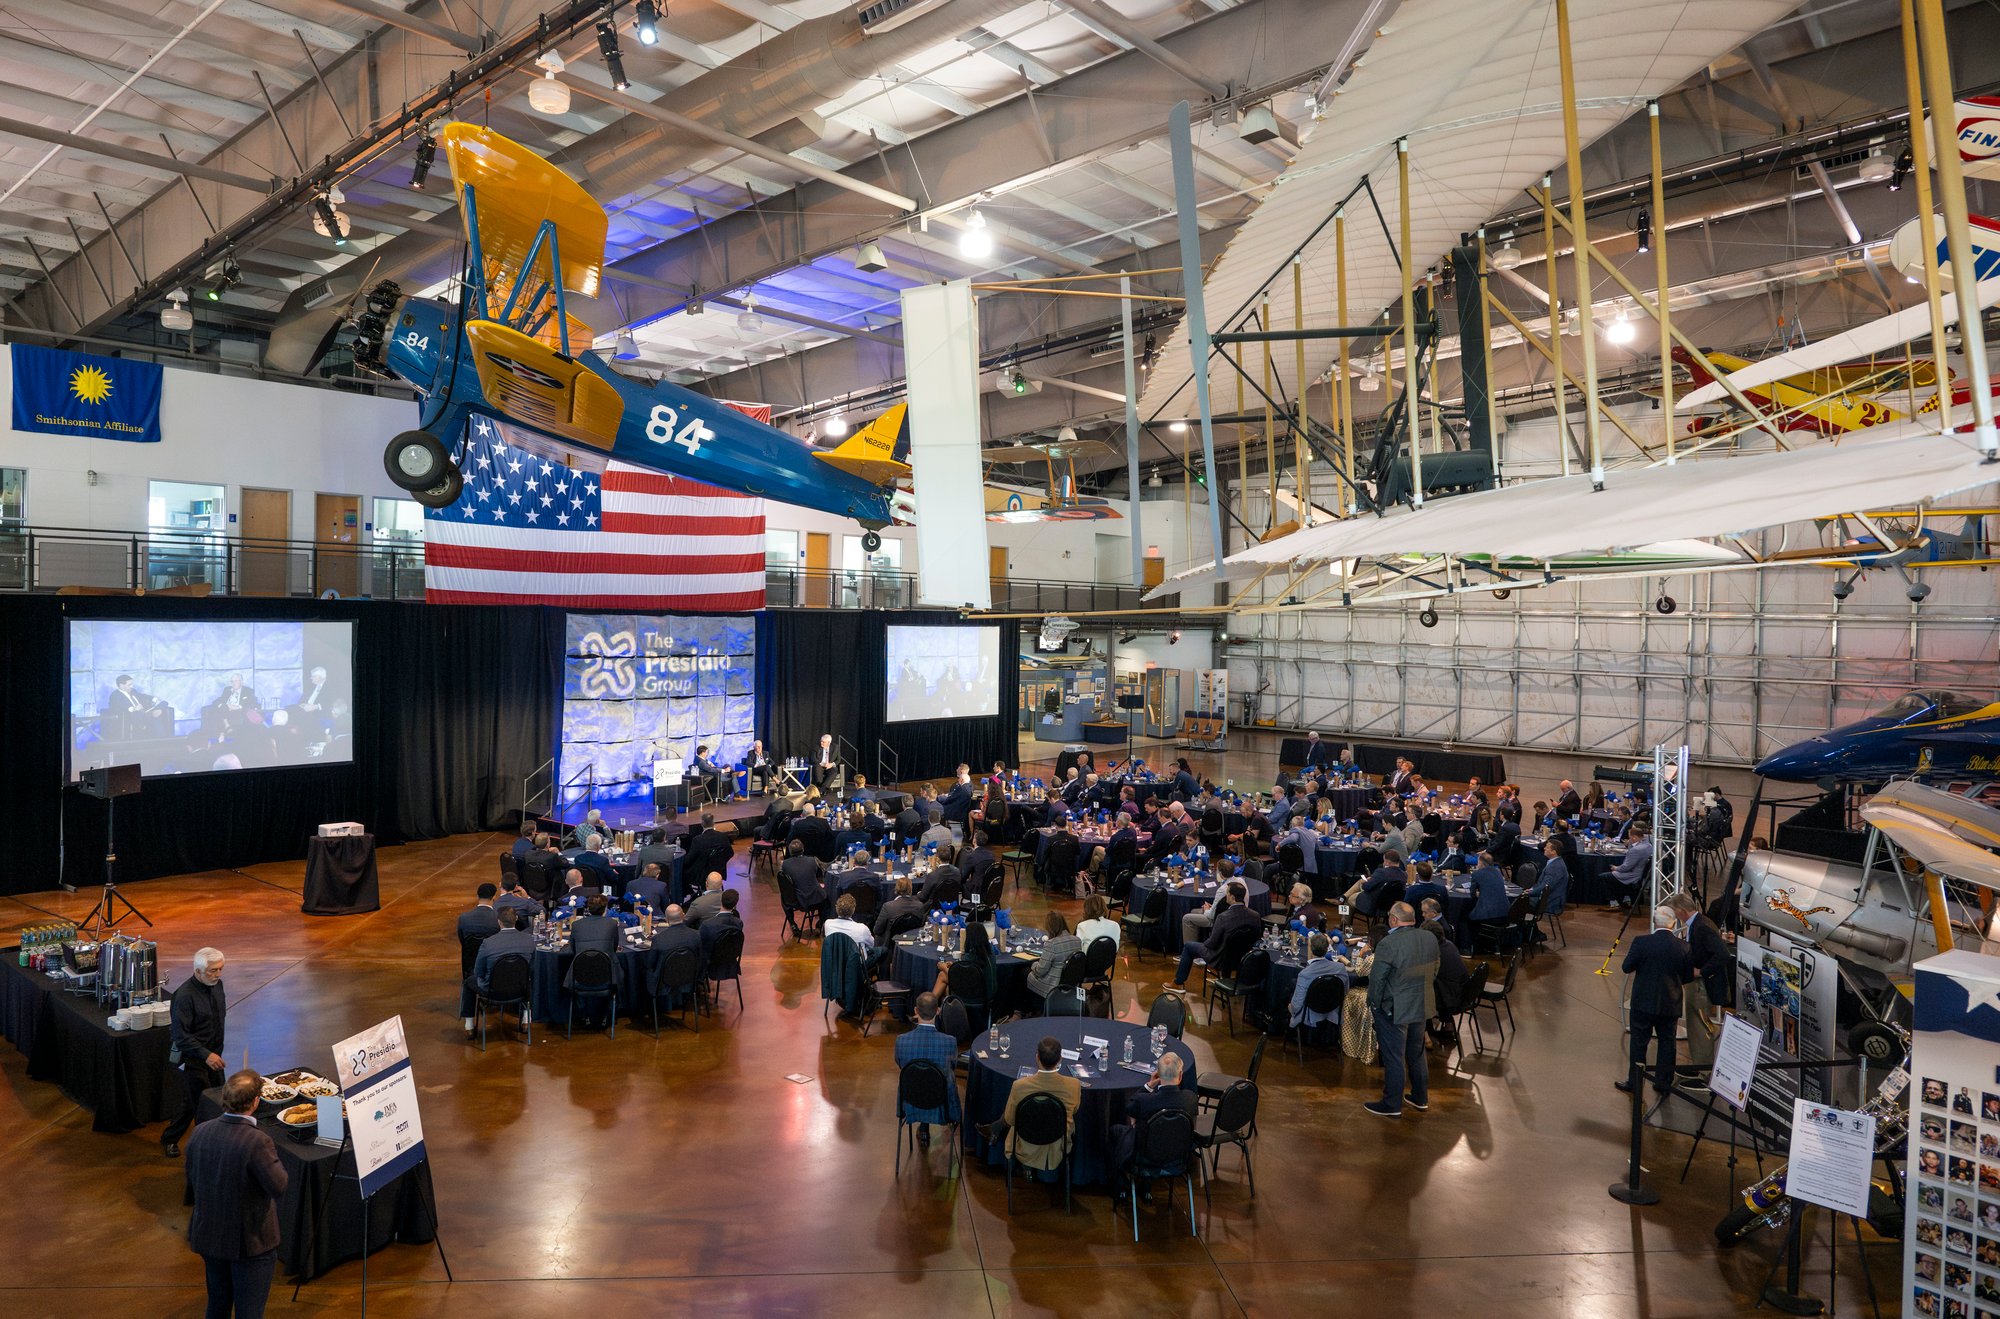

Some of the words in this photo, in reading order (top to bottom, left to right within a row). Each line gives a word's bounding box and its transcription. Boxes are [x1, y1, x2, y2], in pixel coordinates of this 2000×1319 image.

[407, 332, 429, 350] 84
[36, 414, 101, 429] Smithsonian
[104, 420, 144, 433] Affiliate
[645, 404, 705, 455] 84
[864, 436, 890, 451] N62228
[644, 632, 673, 648] The
[644, 648, 732, 673] Presidio
[643, 676, 691, 696] Group
[1078, 988, 1084, 997] 14
[369, 1042, 396, 1060] Presidio
[352, 1096, 366, 1107] Thank
[366, 1090, 376, 1101] you
[381, 1084, 389, 1092] our
